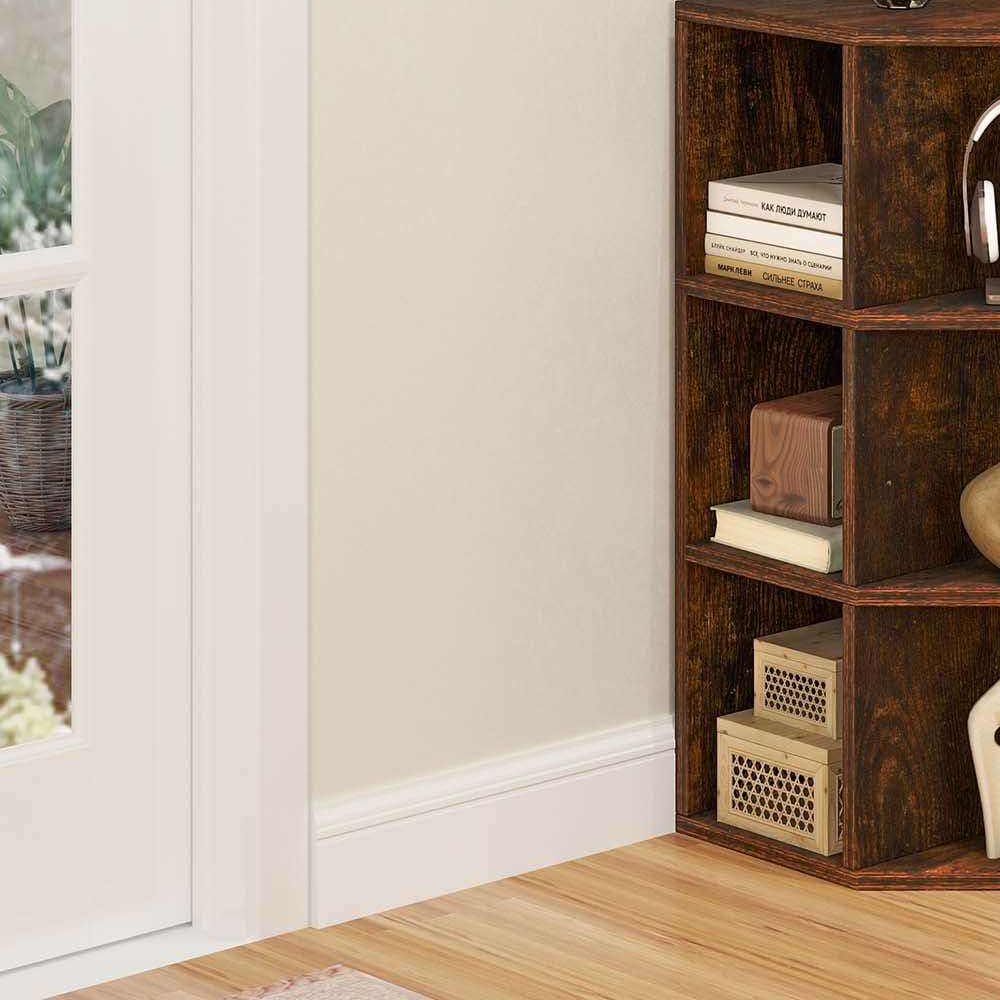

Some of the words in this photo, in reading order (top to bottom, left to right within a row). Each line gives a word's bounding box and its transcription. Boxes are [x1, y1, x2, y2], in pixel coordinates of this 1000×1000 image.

[761, 202, 775, 213] КАК
[775, 204, 797, 216] ЛЮДИ
[797, 208, 827, 222] ДУМАЮТ
[769, 253, 787, 263] НУЖНО
[788, 257, 802, 266] ЗНАТЬ
[807, 261, 832, 271] СЦЕНАРИИ
[762, 272, 795, 286] СИЛЬНЕЕ
[797, 278, 823, 292] СТРАХА
